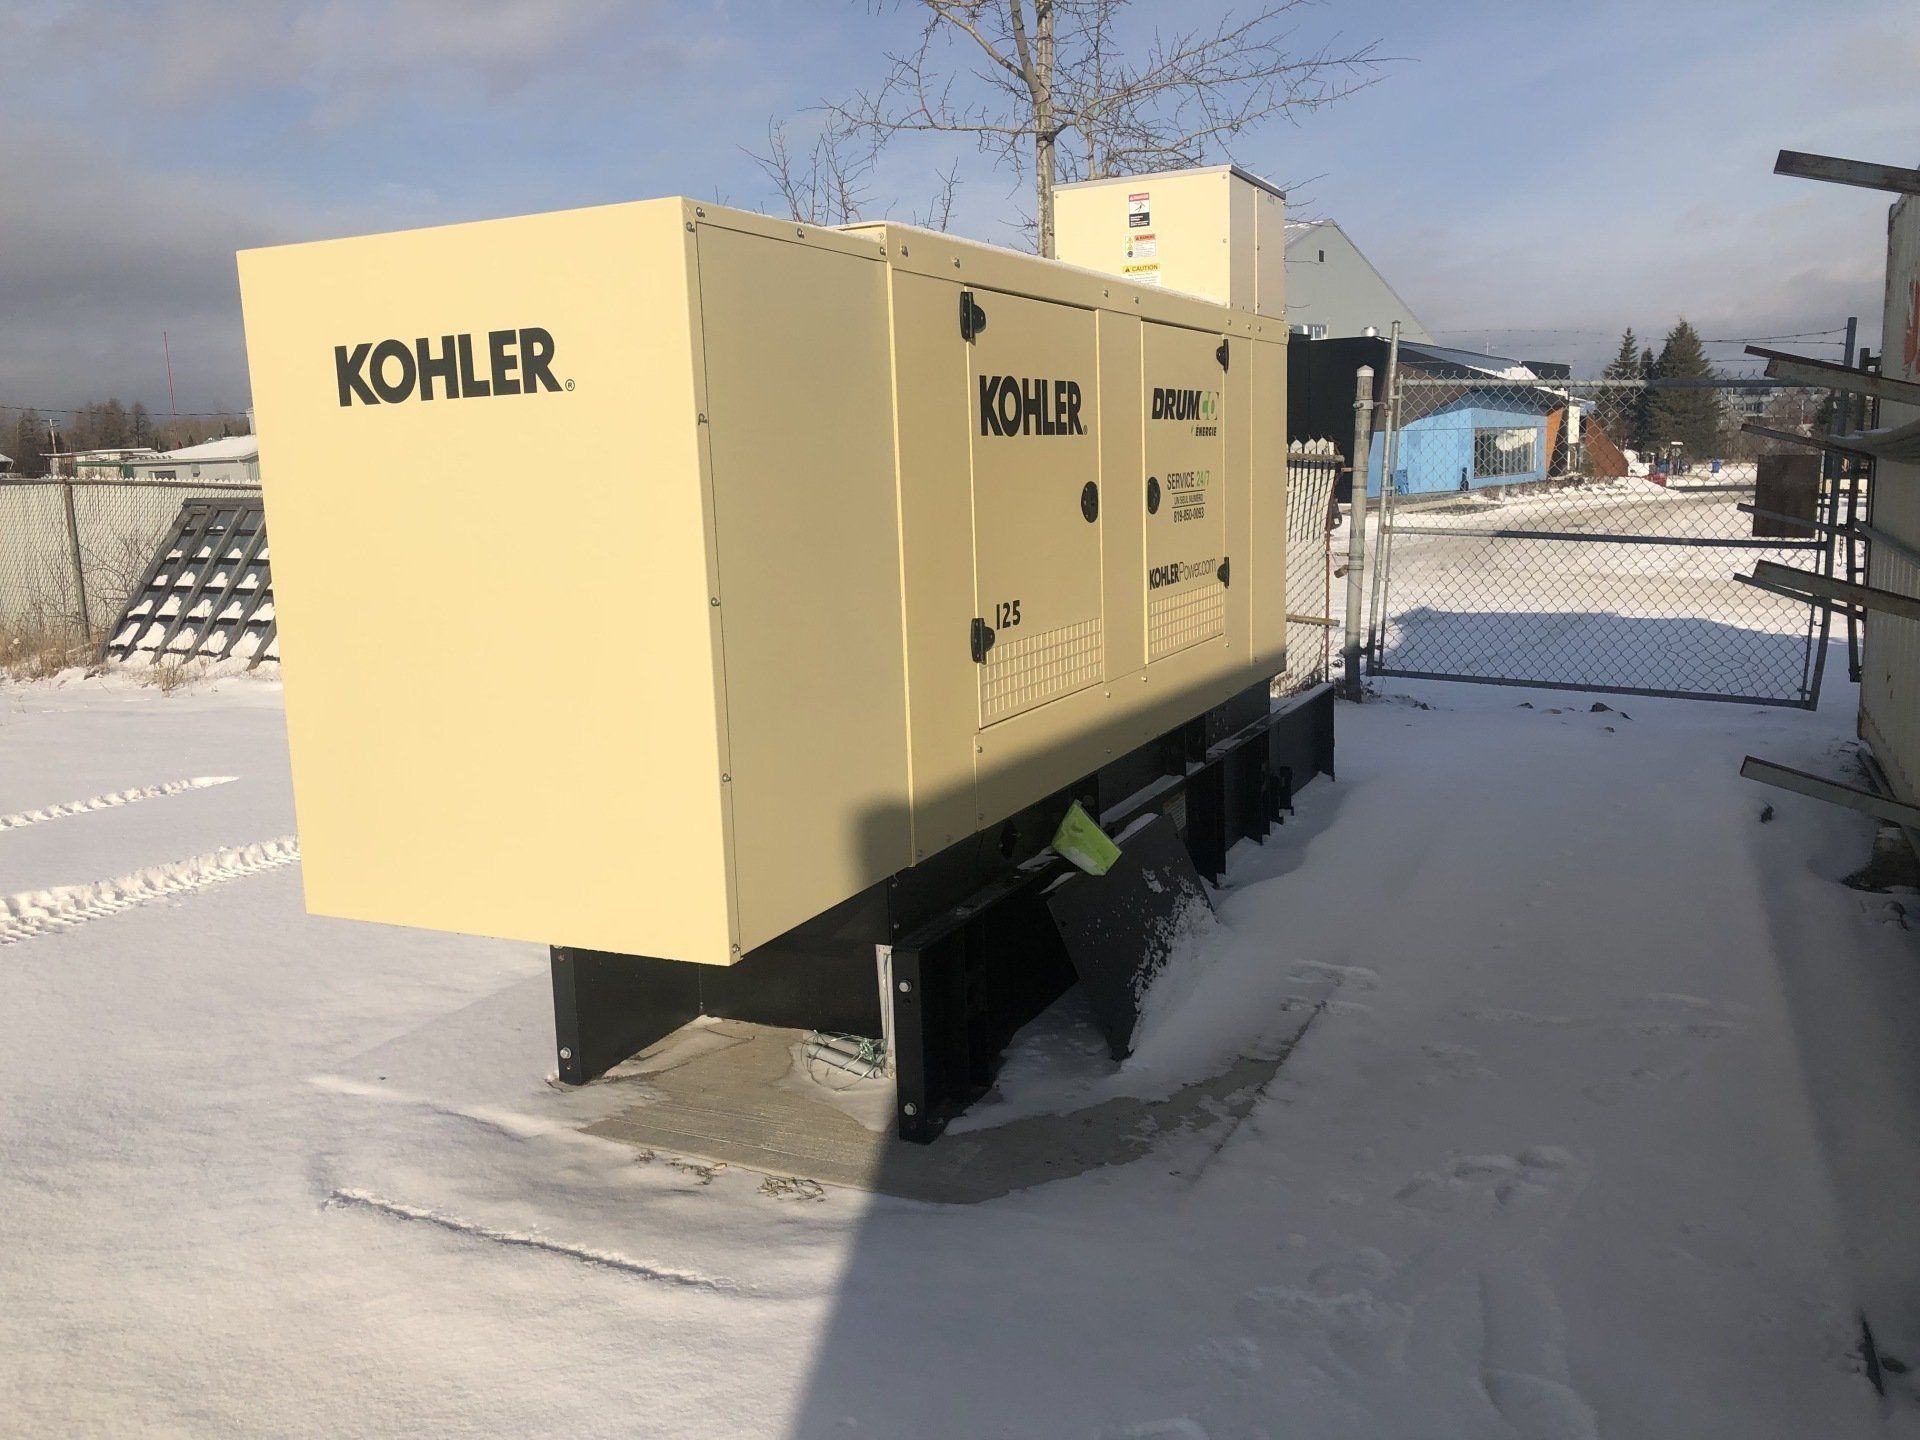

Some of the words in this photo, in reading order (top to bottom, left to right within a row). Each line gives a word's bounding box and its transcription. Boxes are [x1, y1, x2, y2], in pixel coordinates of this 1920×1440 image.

[1131, 263, 1158, 272] CAUTION
[334, 327, 563, 407] KOHLER
[979, 375, 1084, 437] KOHLER
[1167, 471, 1195, 490] SERVICE
[1196, 470, 1210, 487] 24/7
[1149, 559, 1216, 590] KOHLERPower.com
[996, 599, 1021, 630] 125
